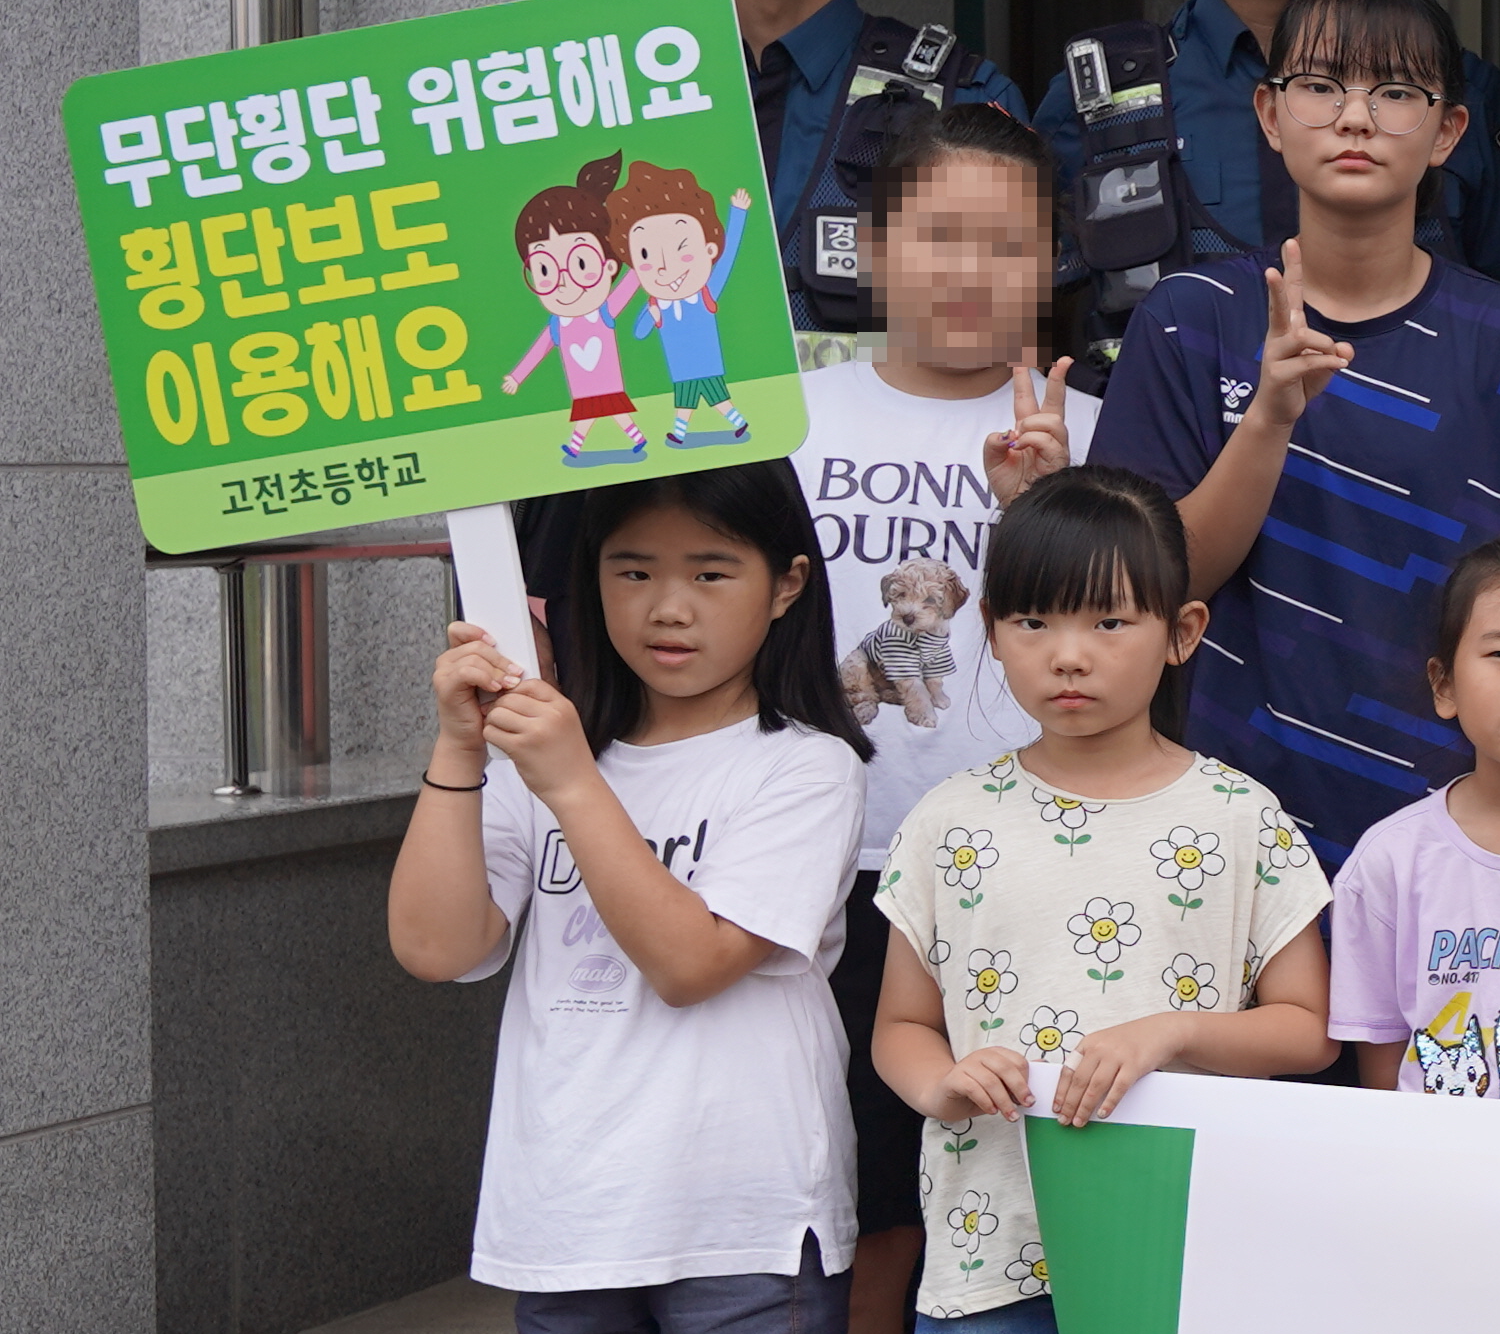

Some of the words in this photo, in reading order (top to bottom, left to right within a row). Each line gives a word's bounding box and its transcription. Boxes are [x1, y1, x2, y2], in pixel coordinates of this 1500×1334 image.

[99, 74, 386, 208] 무단횡단
[409, 26, 713, 156] 위험해요
[120, 180, 460, 331] 횡단보도
[826, 221, 857, 252] 경
[145, 304, 482, 447] 이용해요
[219, 451, 427, 517] 고전초등학교
[816, 457, 1004, 511] BONN
[538, 819, 708, 894] Dr!
